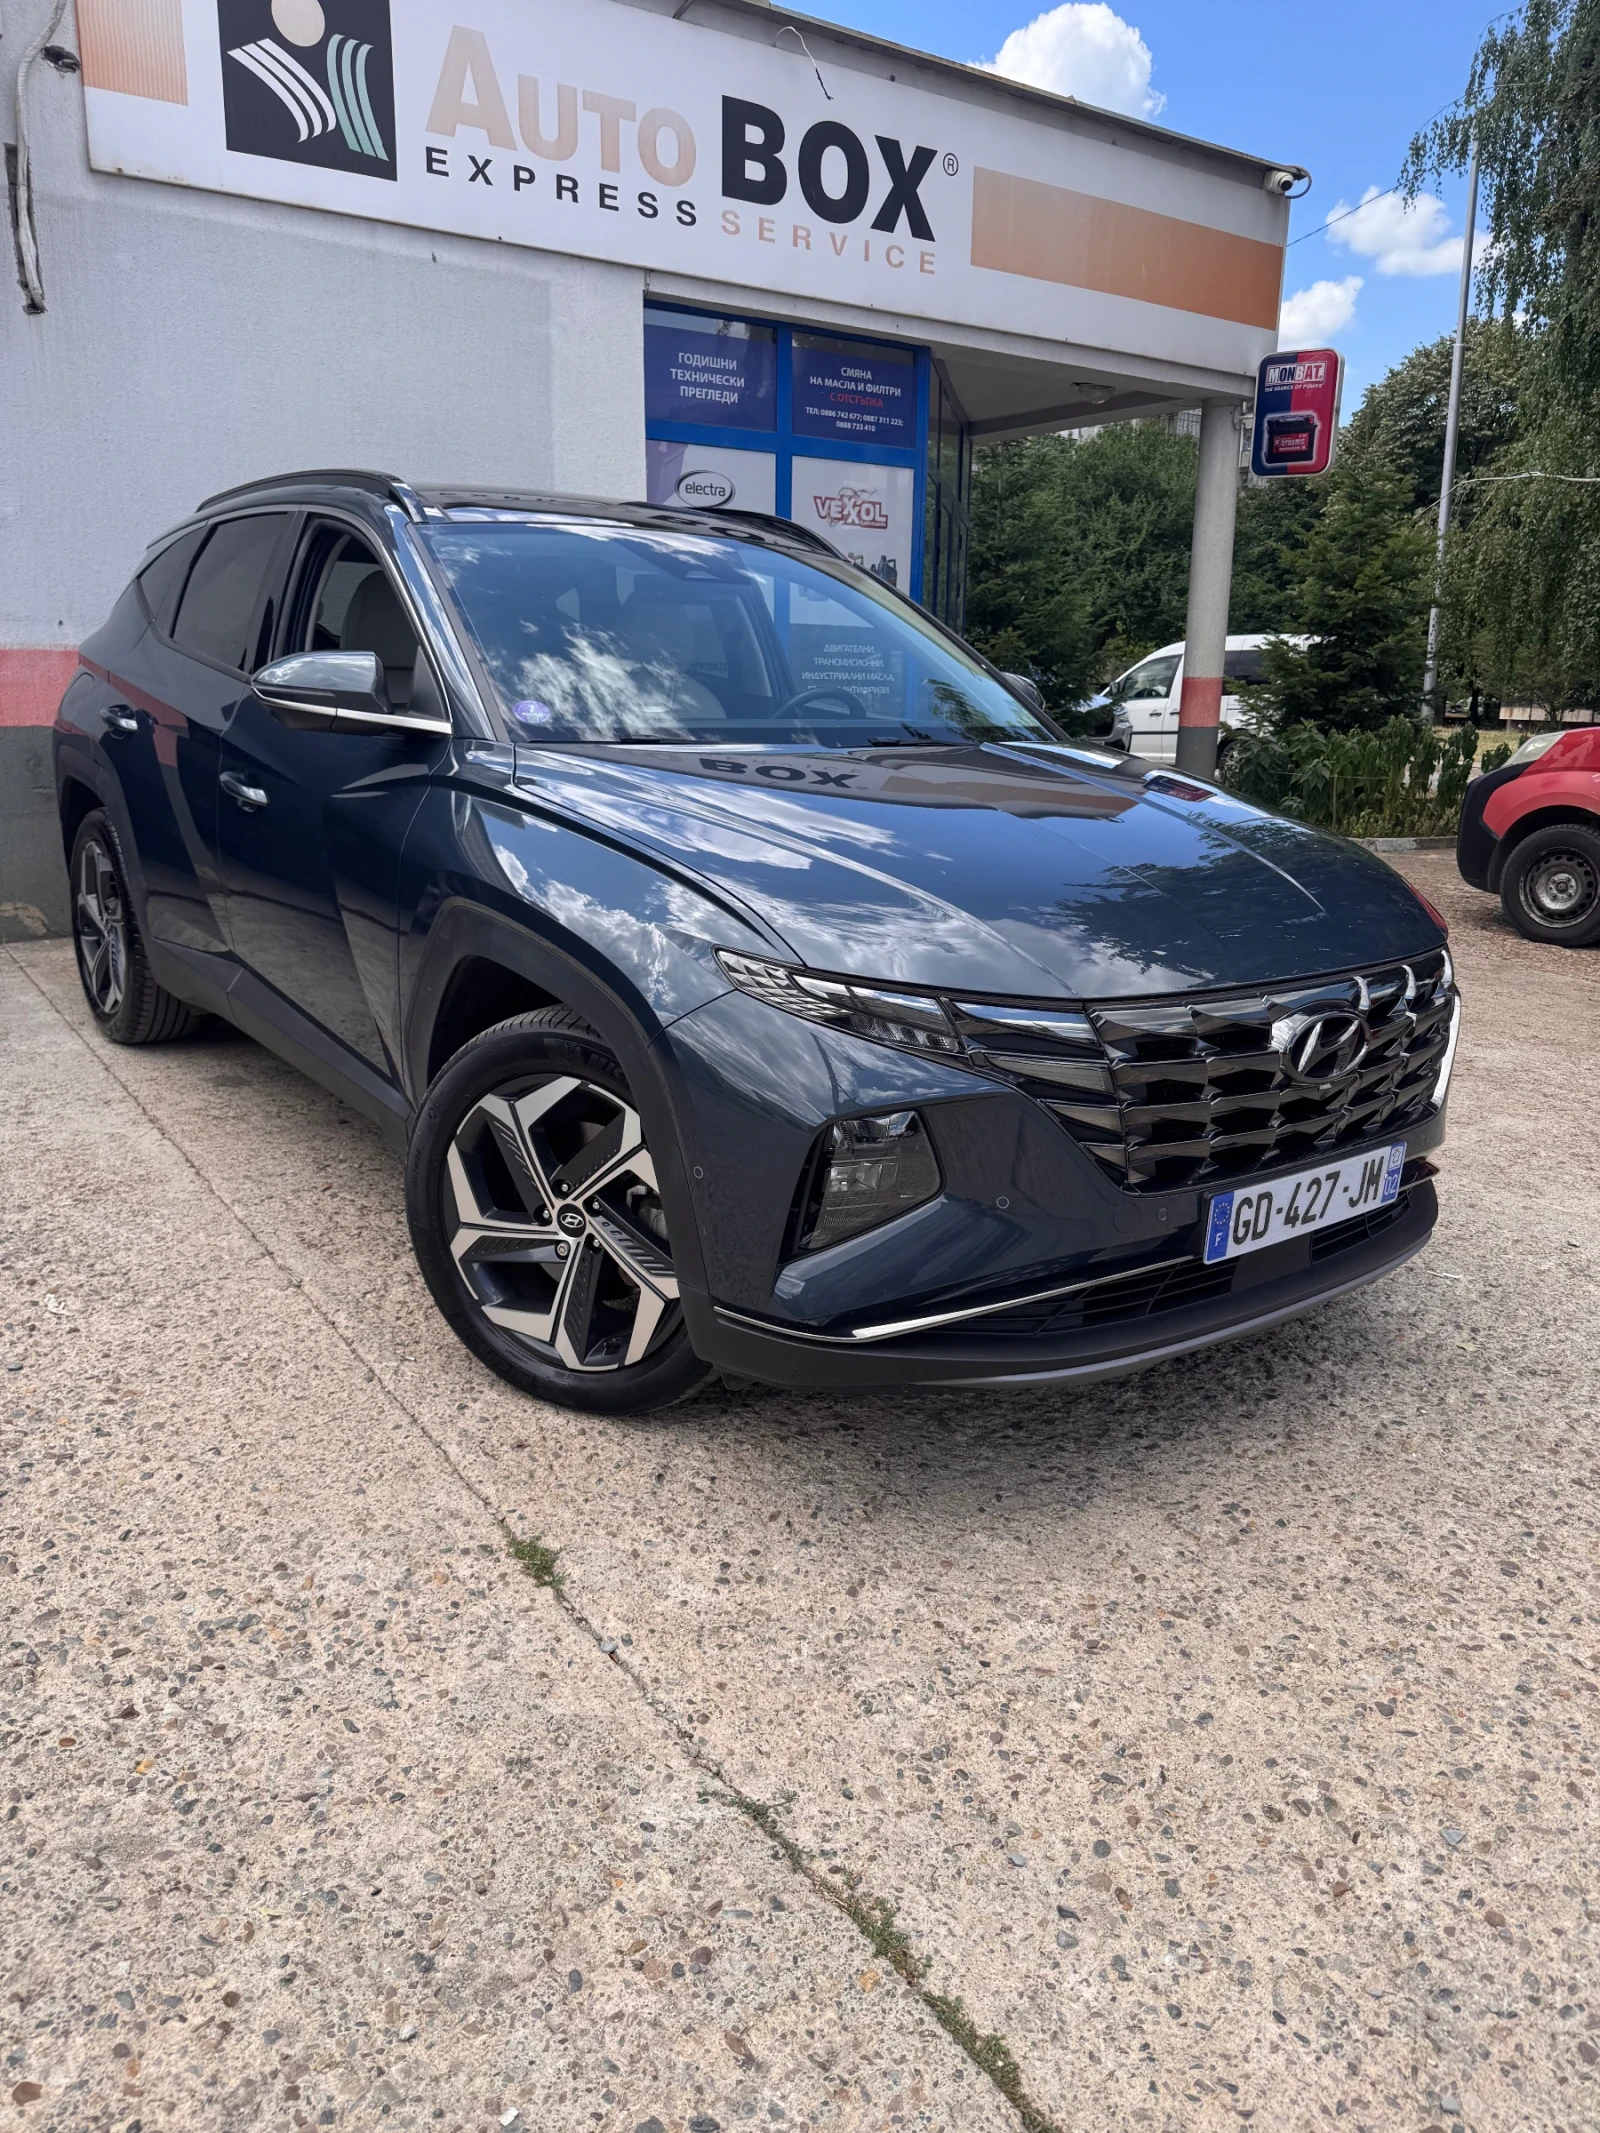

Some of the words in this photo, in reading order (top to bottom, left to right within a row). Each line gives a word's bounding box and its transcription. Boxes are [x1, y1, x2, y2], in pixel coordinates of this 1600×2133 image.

[424, 24, 697, 188] AUTO
[424, 145, 697, 228] EXPRESS
[721, 209, 937, 276] SERVICE
[678, 352, 737, 371] ГОДИШНИ
[669, 368, 745, 388] ТЕХНИЧЕСКИ
[841, 367, 872, 380] СМЯНА
[680, 385, 739, 405] ПРЕГЛЕДИ
[809, 376, 823, 386] НА
[824, 378, 856, 391] МАСЛА
[857, 382, 864, 392] И
[865, 383, 901, 397] ФИЛТРИ
[1274, 384, 1293, 392] SOURCE
[829, 392, 836, 401] С
[837, 393, 884, 408] ОТСТЪПКА
[805, 406, 820, 415] ТЕЛ:
[820, 409, 836, 417] 0886
[837, 411, 848, 419] 742
[862, 414, 878, 423] 0887
[878, 416, 889, 424] 311
[864, 424, 876, 432] 410
[684, 481, 726, 497] electra
[1214, 1232, 1223, 1247] F
[1232, 1156, 1385, 1246] GD-427-JM
[1383, 1173, 1399, 1195] 02
